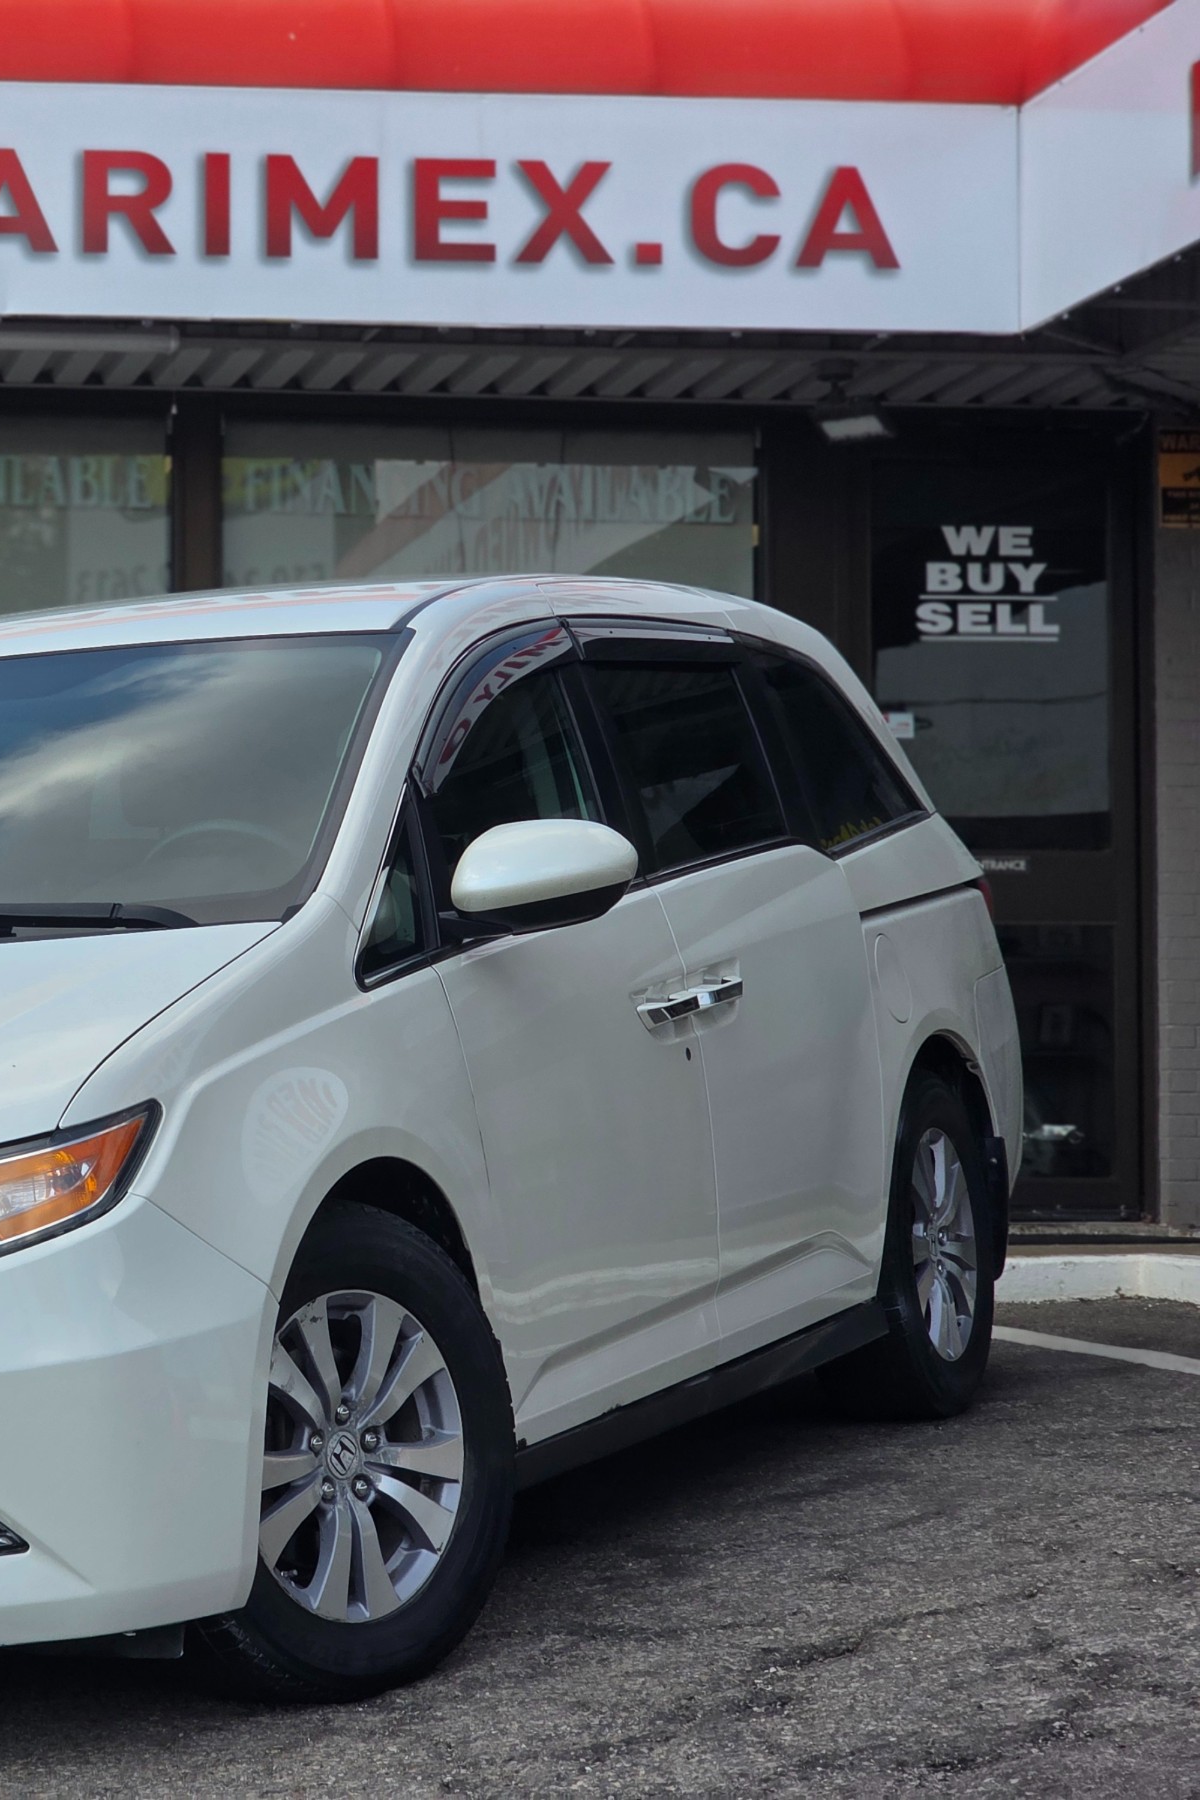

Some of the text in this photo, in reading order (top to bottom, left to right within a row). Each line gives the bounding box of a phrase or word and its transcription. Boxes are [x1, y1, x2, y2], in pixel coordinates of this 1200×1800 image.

[245, 461, 737, 524] FINANING AVAILABLE
[940, 525, 1033, 557] WE
[925, 561, 1048, 594] BUY
[915, 602, 1060, 635] SELL
[975, 859, 1027, 871] NTRANCE
